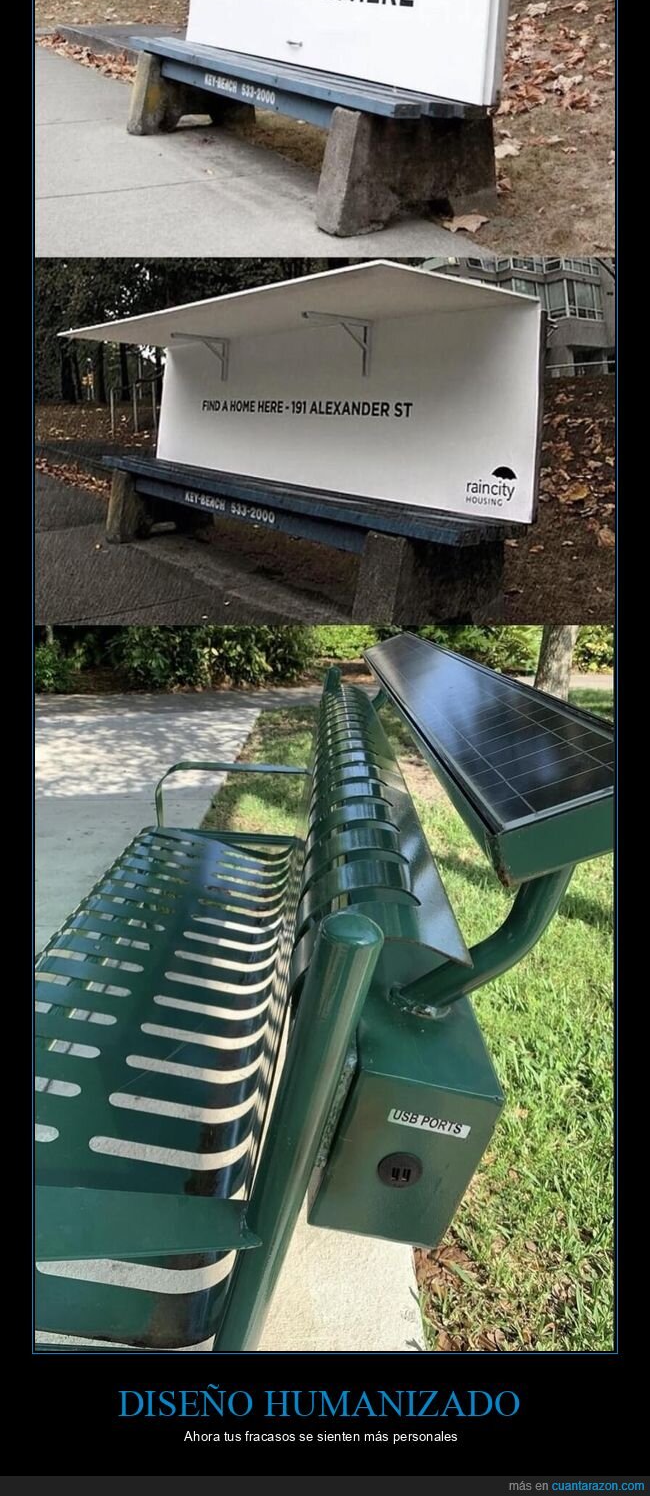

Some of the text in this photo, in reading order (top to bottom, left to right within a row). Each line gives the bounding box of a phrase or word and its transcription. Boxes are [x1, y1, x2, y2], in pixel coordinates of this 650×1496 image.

[202, 400, 220, 412] FIND
[222, 400, 228, 411] A
[231, 400, 255, 412] HOME
[258, 401, 283, 413] HERE
[291, 401, 306, 415] 191
[309, 401, 389, 417] ALEXANDER
[394, 402, 413, 418] ST
[466, 479, 515, 501] raincity
[465, 496, 503, 507] HOUSING
[393, 1110, 463, 1134] USB PORTS
